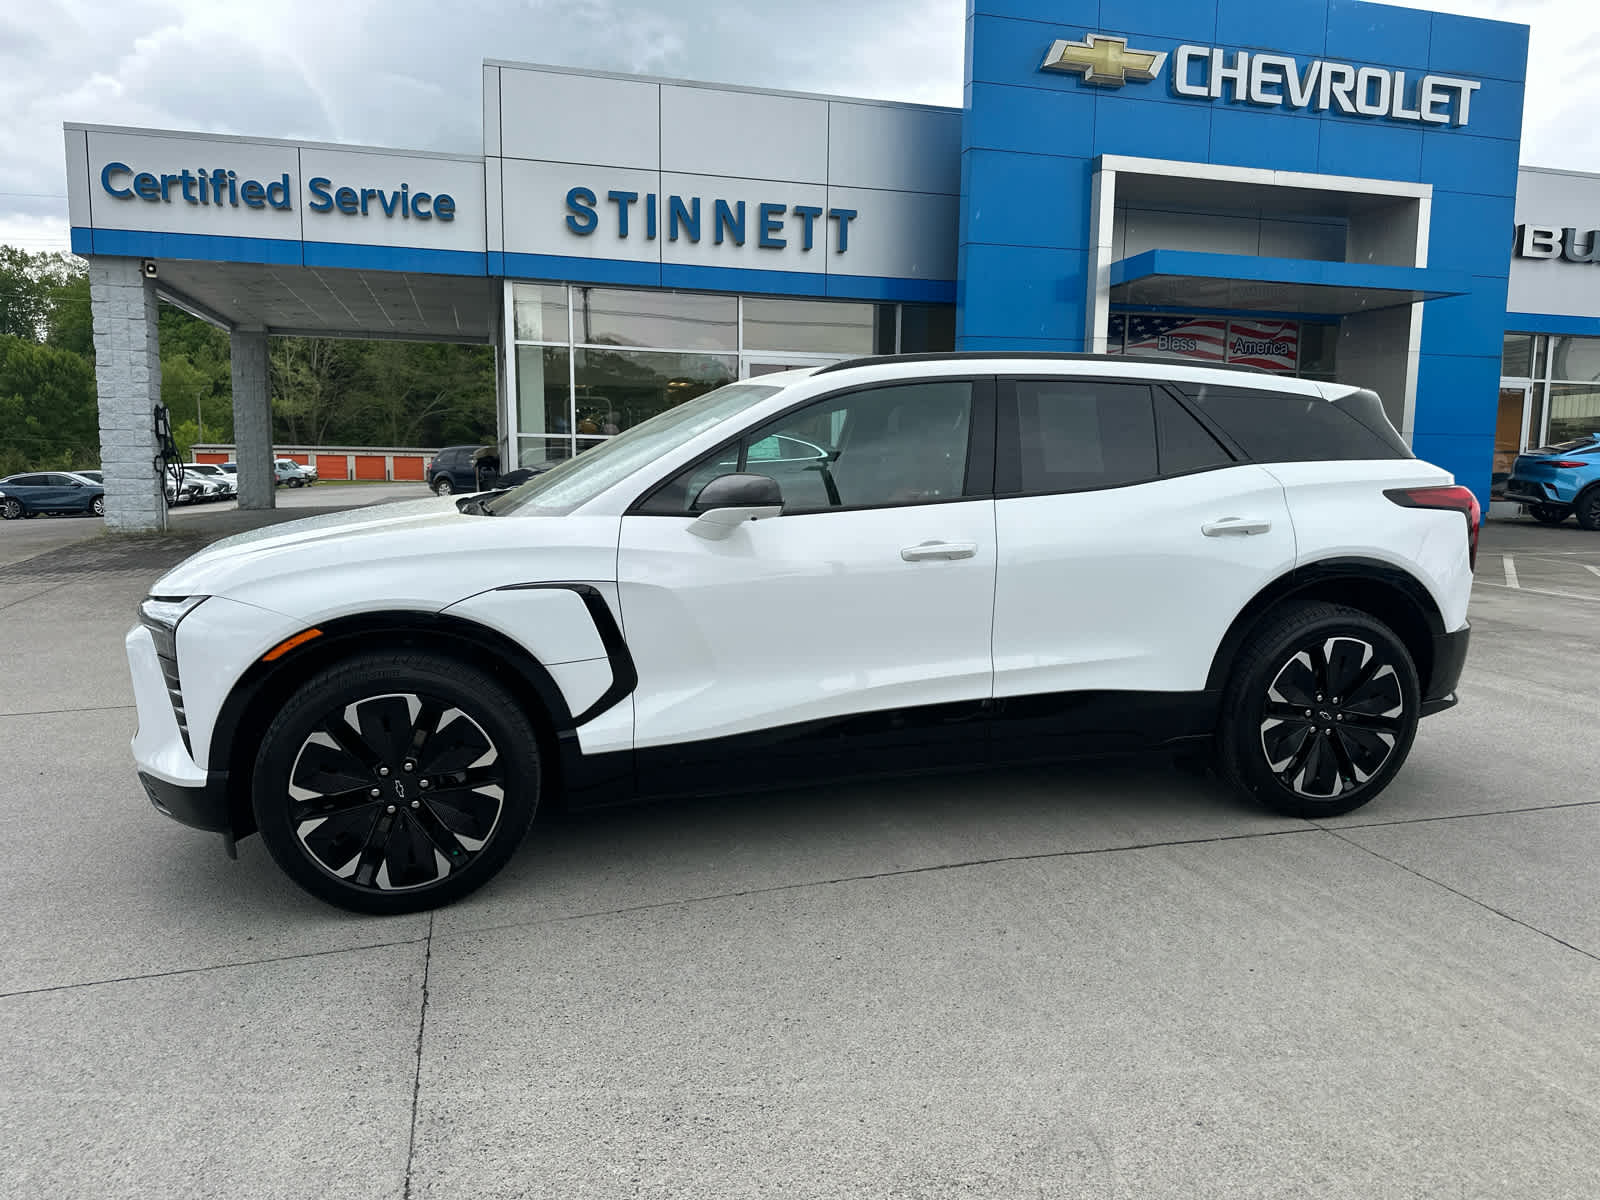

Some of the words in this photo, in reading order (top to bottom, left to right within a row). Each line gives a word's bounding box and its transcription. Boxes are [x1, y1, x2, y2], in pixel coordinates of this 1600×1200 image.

[1173, 45, 1481, 127] CHEVROLET
[101, 161, 291, 211] Certified
[308, 177, 456, 220] Service
[565, 186, 858, 254] STINNETT
[1157, 335, 1197, 352] Bless
[1233, 337, 1289, 356] America
